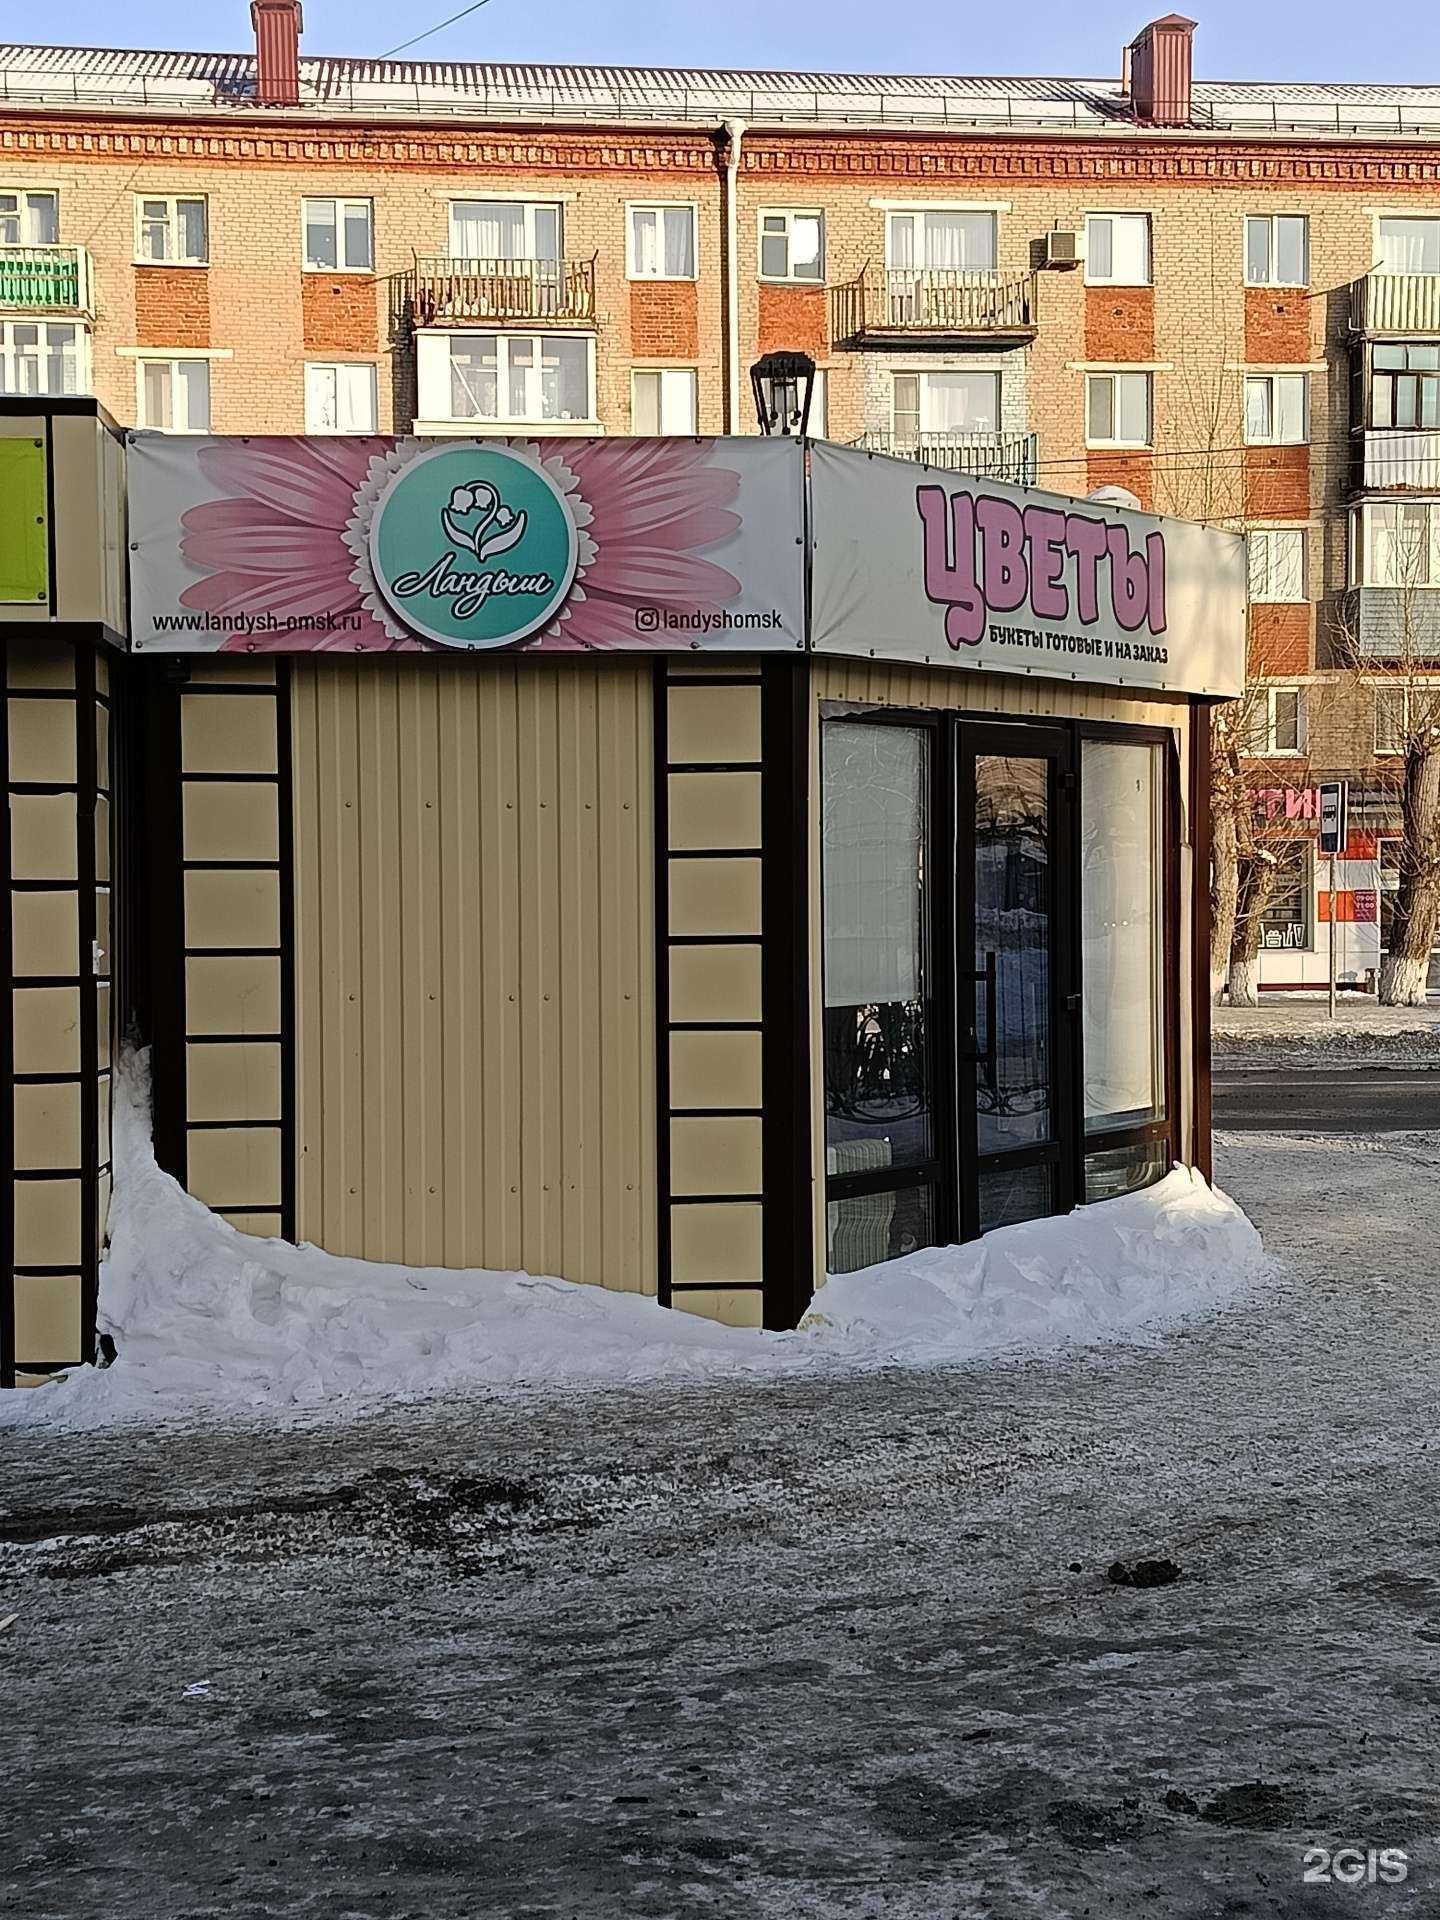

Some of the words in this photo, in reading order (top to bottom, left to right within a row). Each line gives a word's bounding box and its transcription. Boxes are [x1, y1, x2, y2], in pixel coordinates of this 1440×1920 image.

[391, 551, 554, 620] Ландыш
[916, 485, 1167, 650] ЦВЕТЫ
[153, 611, 361, 634] www.landysh-omsk.ru
[663, 609, 783, 633] landyshomsk
[989, 625, 1043, 649] БУКЕТЫ
[1045, 632, 1102, 656] ГОТОВЫЕ
[1104, 641, 1114, 657] И
[1115, 642, 1132, 660] НА
[1133, 644, 1168, 664] ЗАКАЗ
